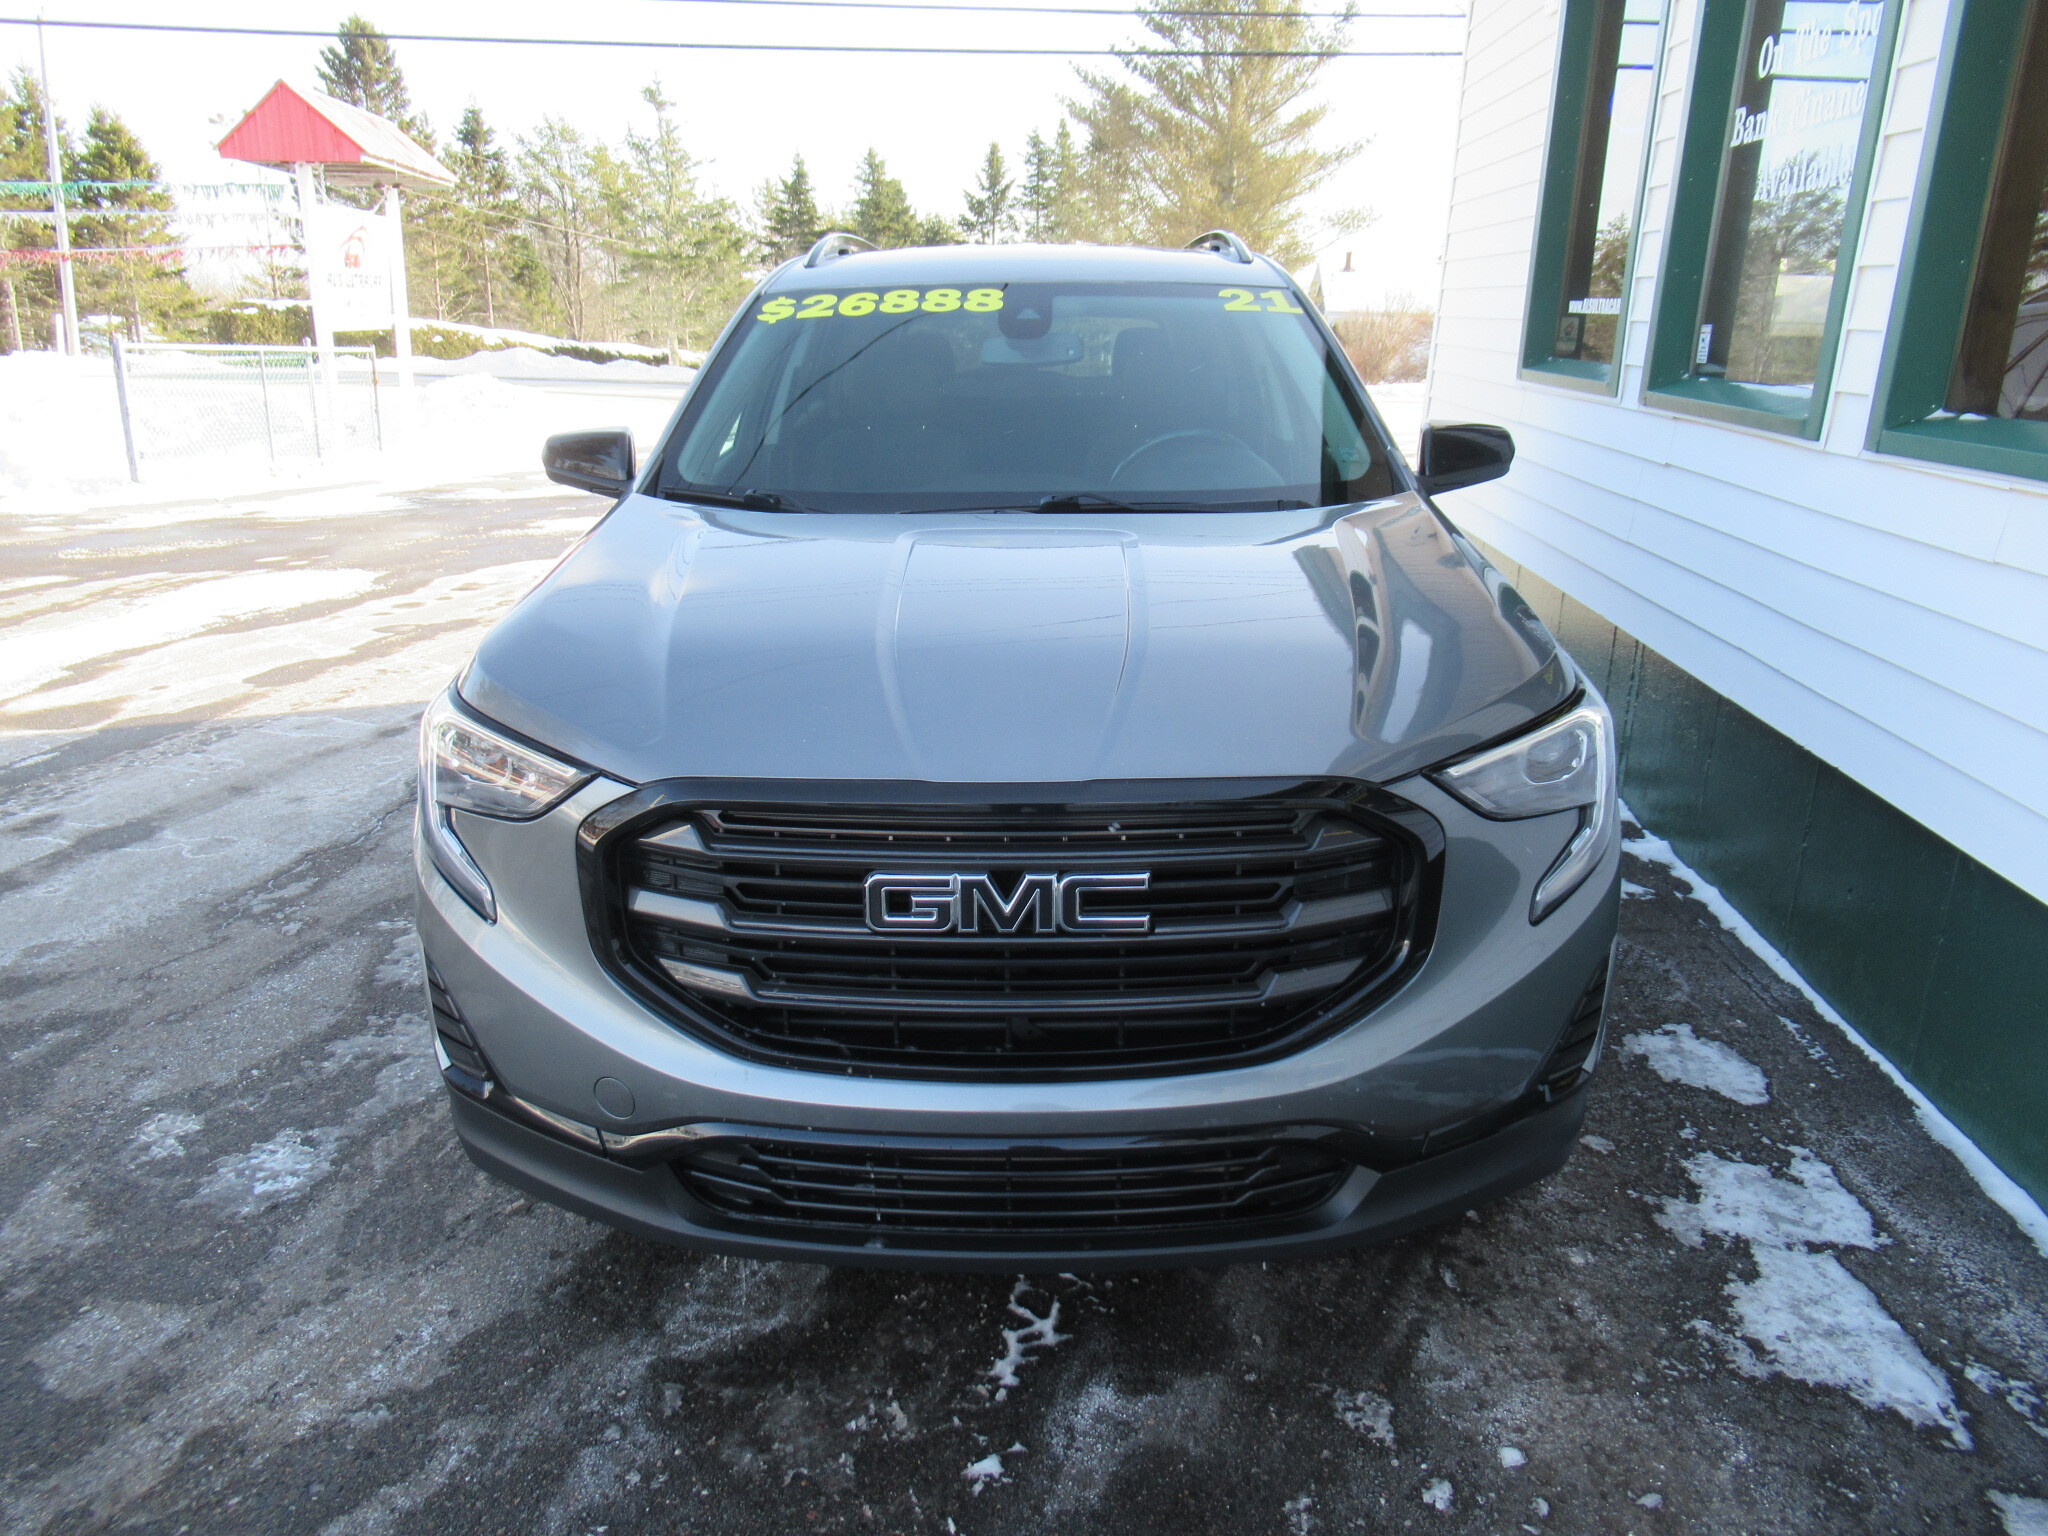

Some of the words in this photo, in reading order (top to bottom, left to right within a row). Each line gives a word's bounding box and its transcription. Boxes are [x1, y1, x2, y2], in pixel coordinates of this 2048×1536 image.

[1758, 35, 1785, 79] On
[1794, 17, 1832, 66] The
[1730, 97, 1781, 148] Bank
[757, 288, 1004, 324] $26888
[1218, 288, 1303, 314] 21
[864, 871, 1150, 933] GMC
